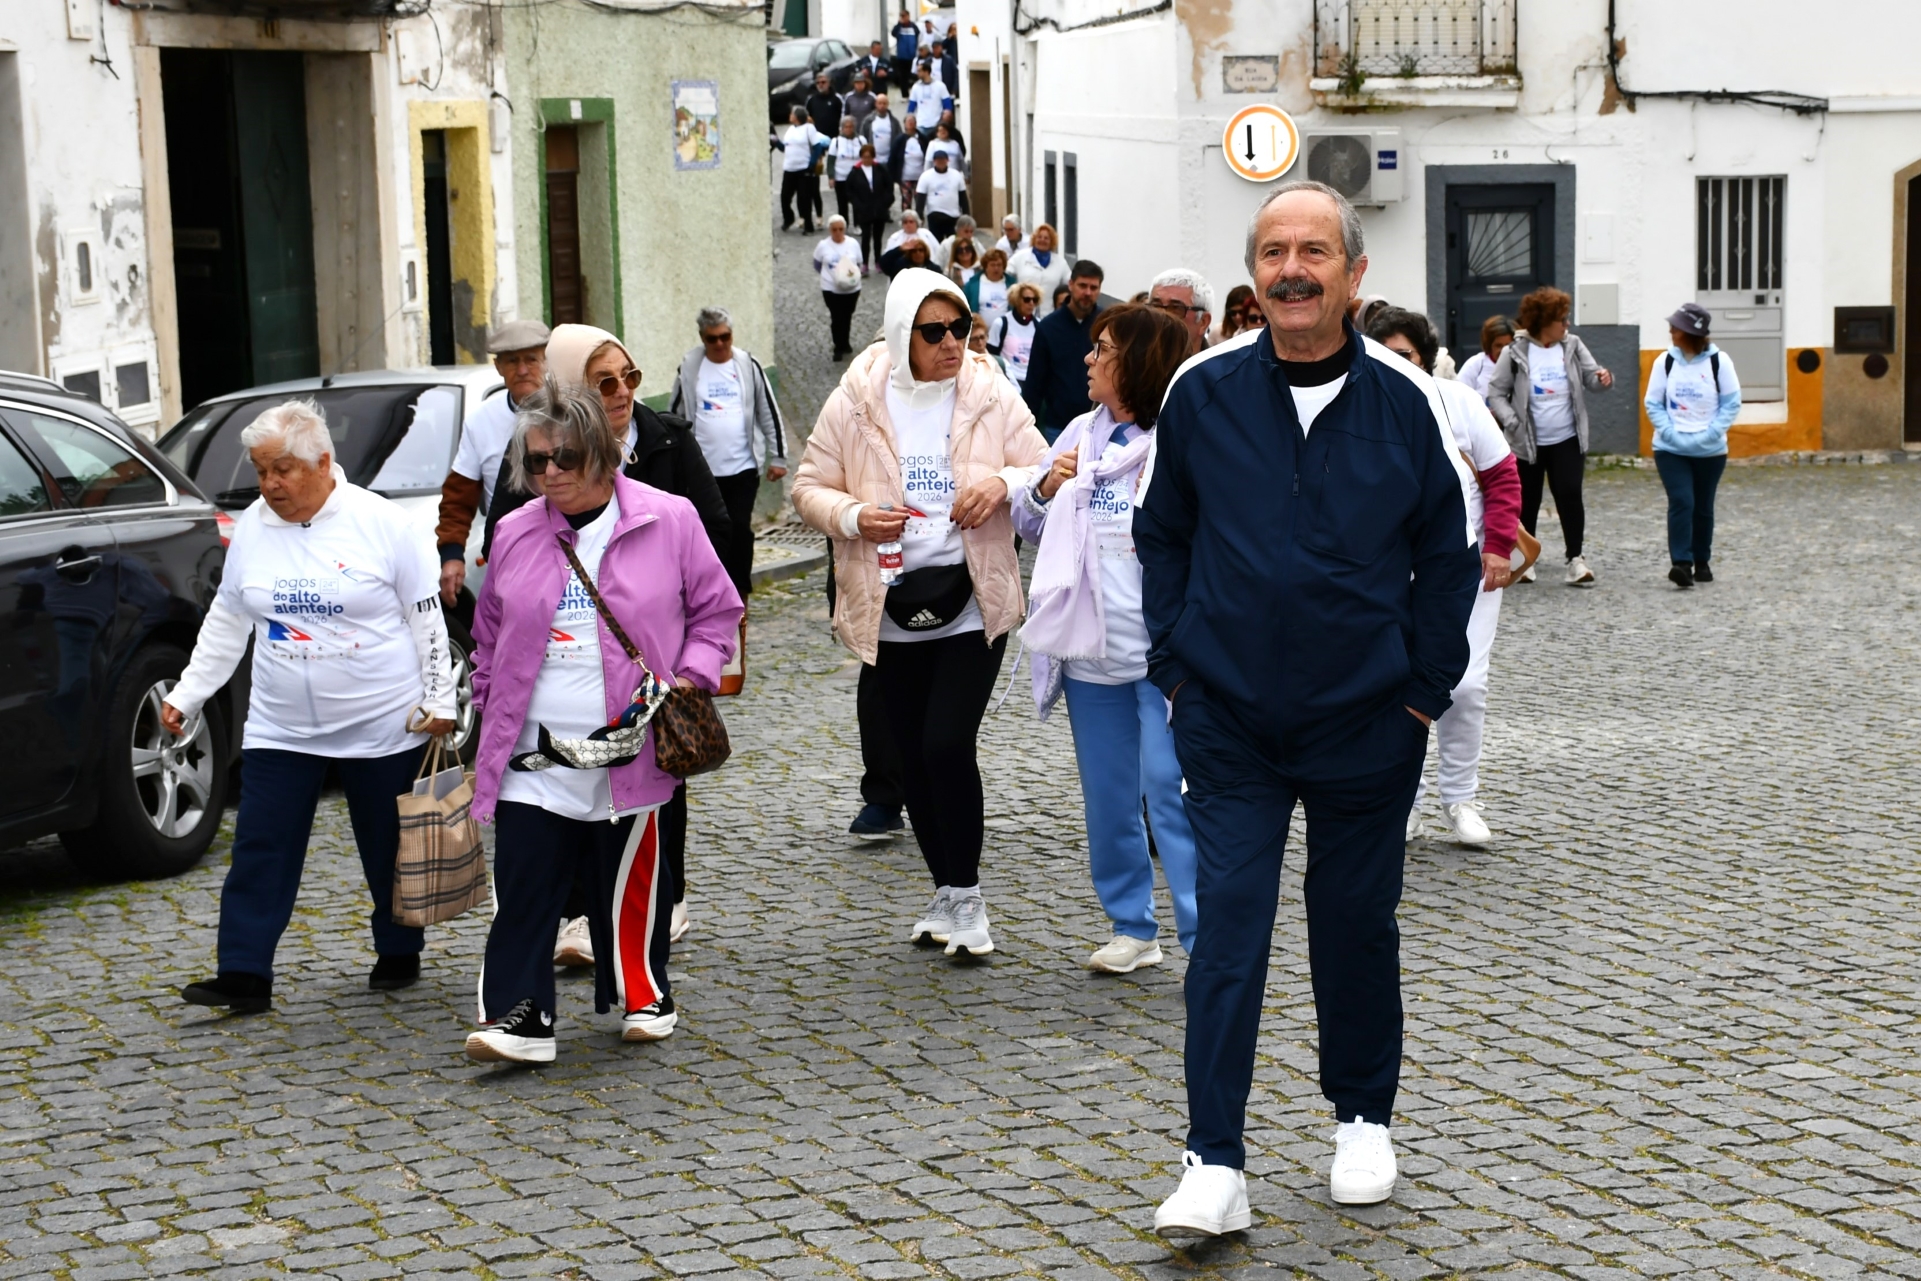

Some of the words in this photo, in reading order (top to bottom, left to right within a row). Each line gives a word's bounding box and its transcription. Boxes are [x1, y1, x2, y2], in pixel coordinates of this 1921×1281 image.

[908, 467, 938, 480] alto
[918, 493, 942, 501] 2026
[1091, 512, 1112, 521] 2026
[272, 577, 317, 591] jogos
[273, 592, 287, 602] do
[289, 590, 321, 603] alto
[274, 601, 344, 616] alentejo
[301, 615, 328, 624] 2026
[567, 611, 595, 621] 2026
[908, 618, 942, 627] adidas
